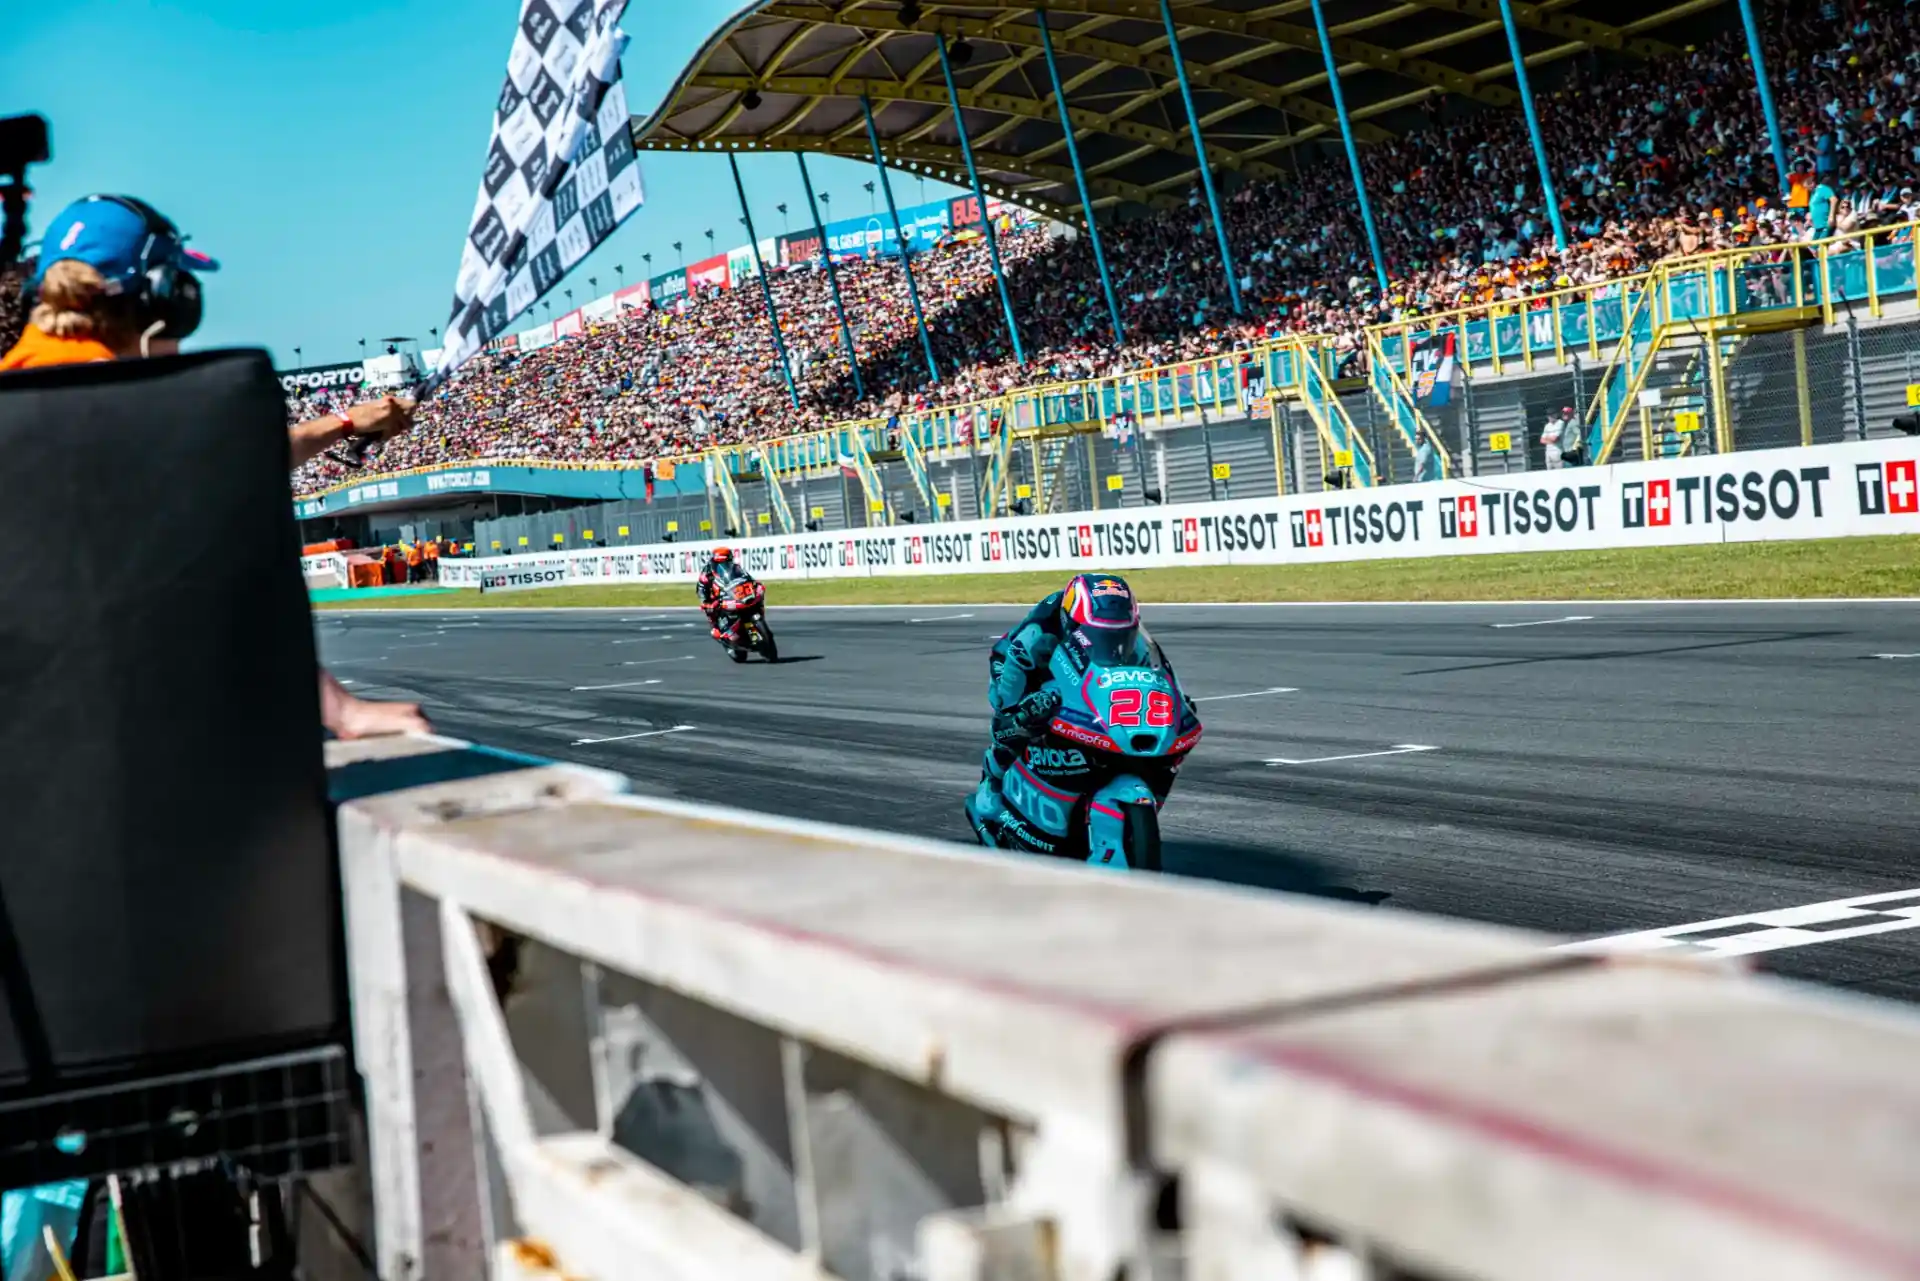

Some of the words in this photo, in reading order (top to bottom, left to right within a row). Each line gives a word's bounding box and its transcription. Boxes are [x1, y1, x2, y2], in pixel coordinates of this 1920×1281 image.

[1496, 435, 1506, 449] 8
[1481, 485, 1601, 536] TISSOT
[1676, 466, 1830, 524] TISSOT
[1098, 520, 1163, 555] TISSOT
[1200, 513, 1278, 551] TISSOT
[1325, 500, 1424, 545] TISSOT
[741, 546, 775, 571] TISSOT
[797, 541, 834, 568] TISSOT
[855, 538, 896, 566] TISSOT
[922, 533, 972, 564] TISSOT
[1001, 527, 1061, 560] TISSOT
[511, 570, 566, 585] TISSOT
[1109, 688, 1174, 727] 28
